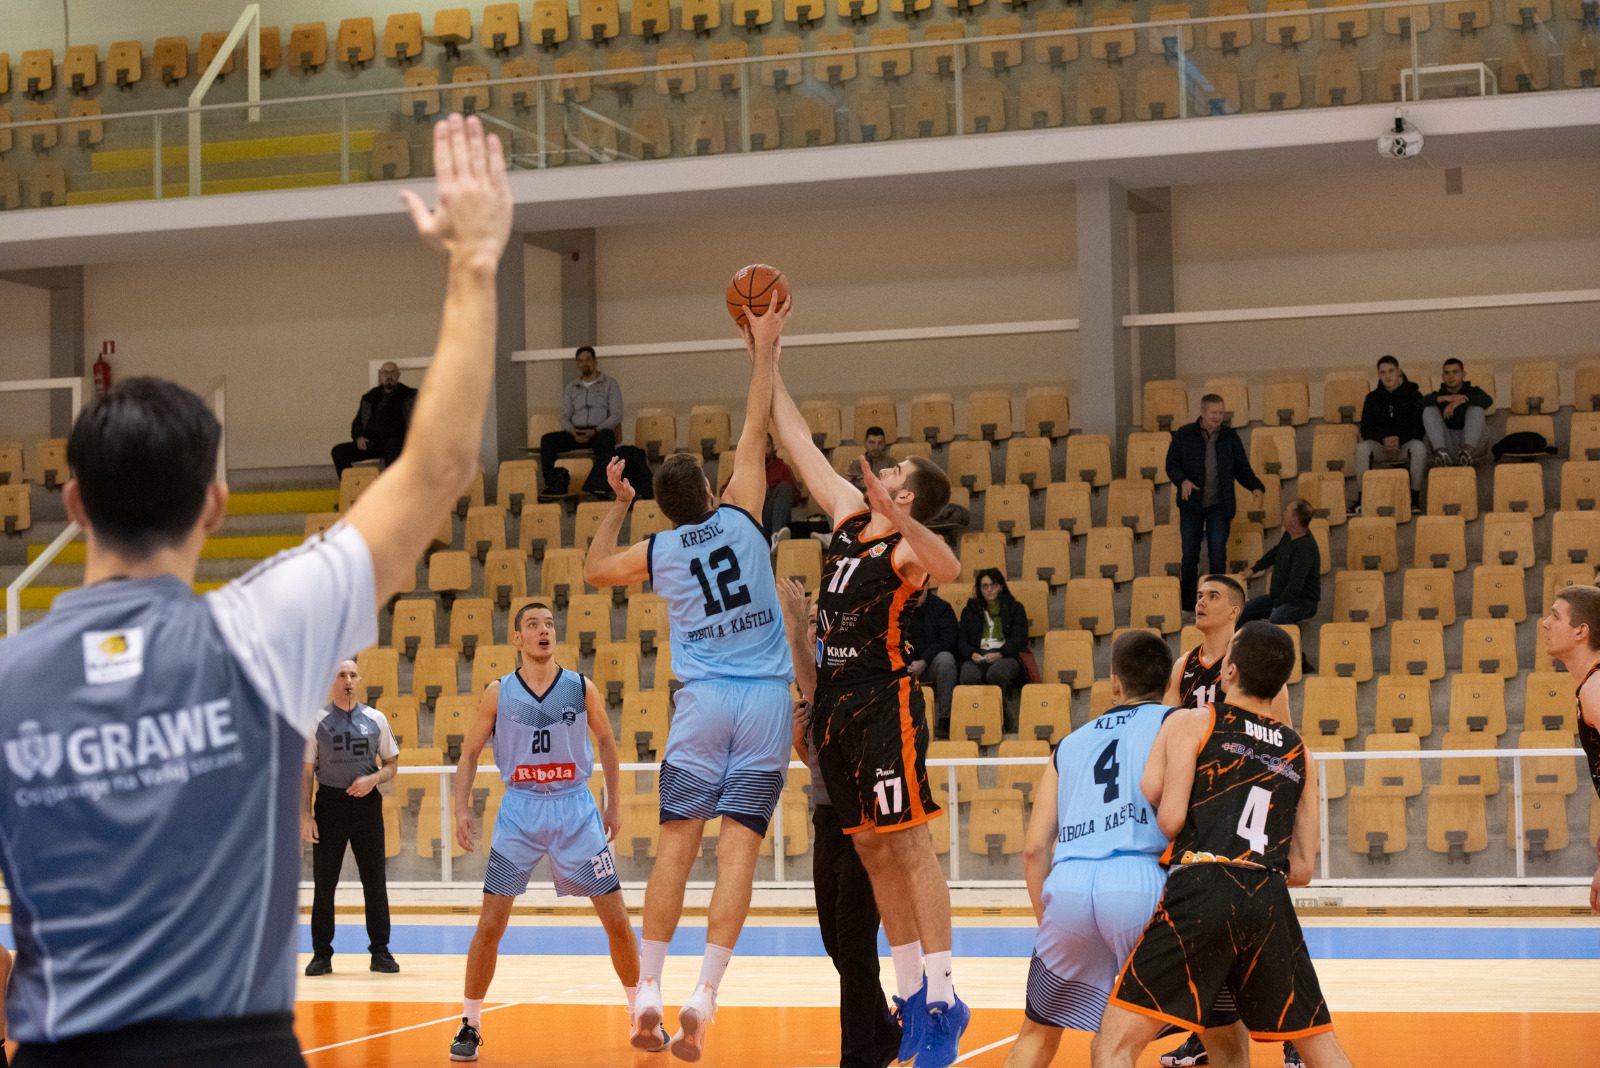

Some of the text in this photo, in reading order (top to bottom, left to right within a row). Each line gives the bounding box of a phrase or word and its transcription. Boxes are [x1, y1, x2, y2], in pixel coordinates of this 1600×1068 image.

[690, 545, 752, 617] 12
[827, 556, 861, 594] 17
[730, 608, 775, 634] KAŠTELA
[827, 646, 859, 658] KRKA
[1193, 684, 1216, 708] 11
[66, 698, 239, 776] GRAWE
[532, 730, 551, 754] 20
[1244, 719, 1284, 748] BULIĆ
[517, 766, 573, 781] Ribola
[1094, 738, 1120, 804] 4
[873, 776, 902, 815] 17
[1236, 785, 1272, 855] 4
[591, 851, 614, 879] 20
